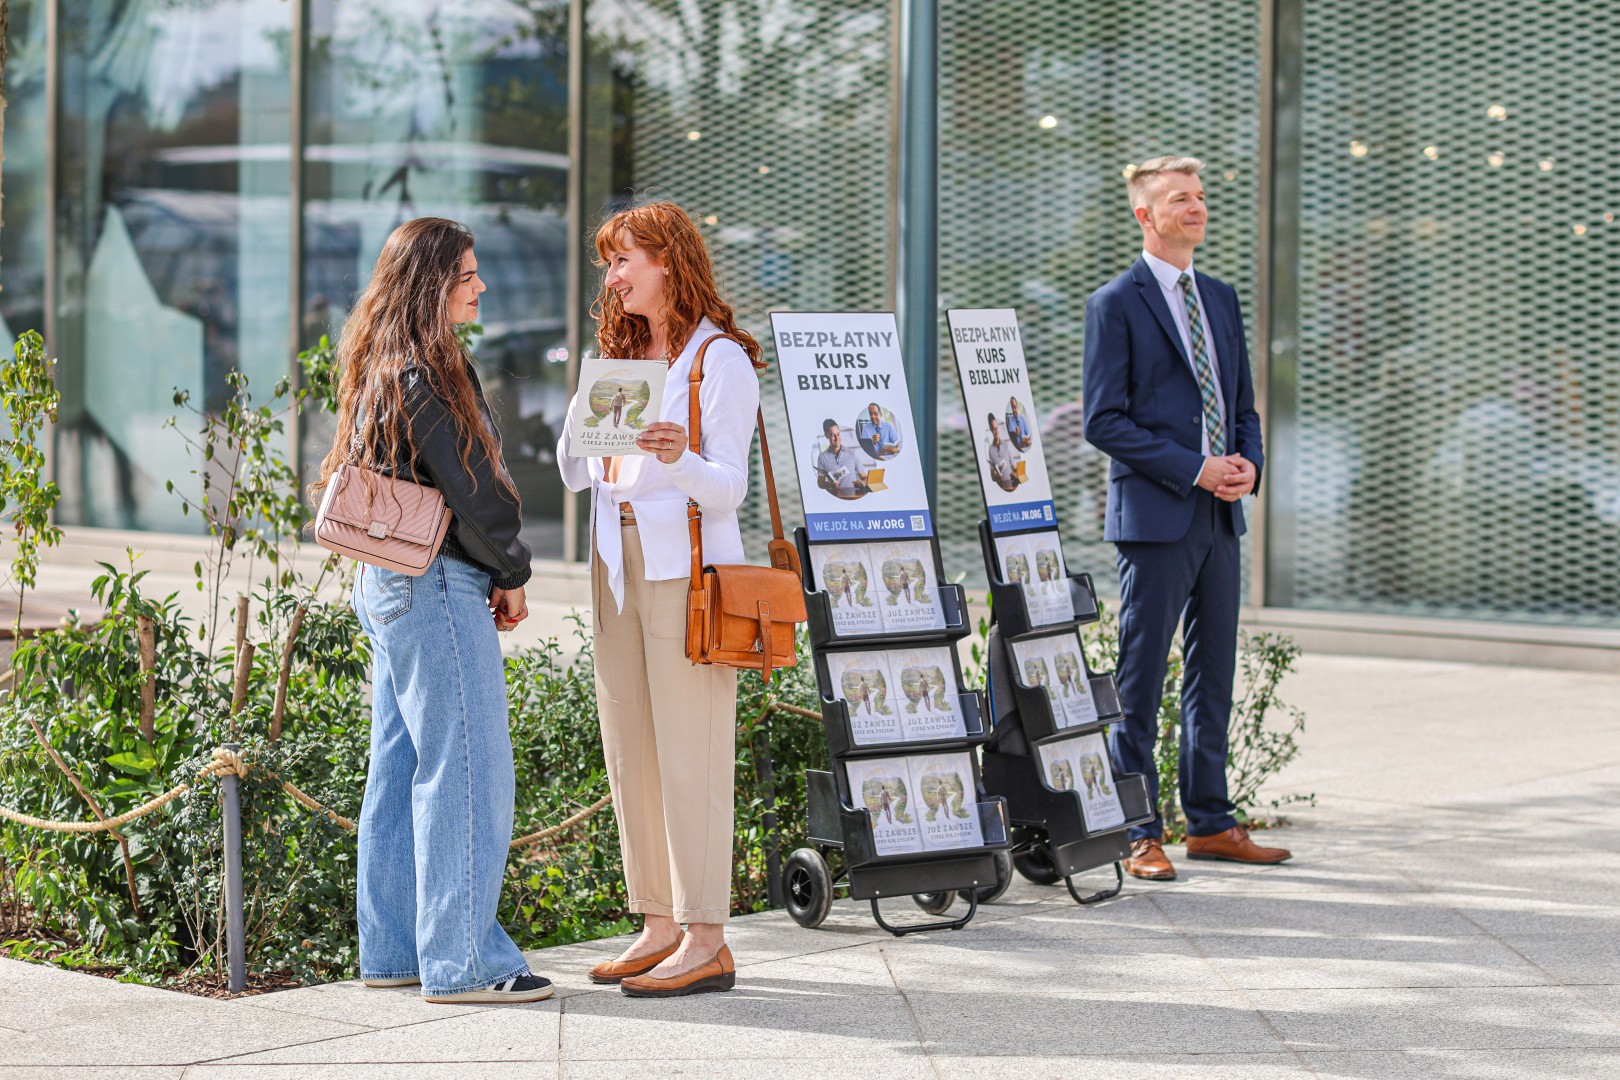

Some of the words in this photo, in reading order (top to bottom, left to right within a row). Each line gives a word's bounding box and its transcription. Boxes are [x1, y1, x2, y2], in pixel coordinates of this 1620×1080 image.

[779, 331, 892, 347] BEZPŁATNY
[954, 327, 1016, 343] BEZPŁATNY
[815, 353, 868, 368] KURS
[976, 347, 1006, 363] KURS
[797, 374, 891, 390] BIBLIJNY
[968, 368, 1020, 385] BIBLIJNY
[580, 431, 601, 440] JUŻ
[604, 432, 641, 441] ZAWSZ
[813, 519, 848, 531] WEJDŹ
[850, 520, 864, 530] NA
[867, 519, 905, 530] JW.ORG
[833, 612, 844, 620] UŻ
[845, 611, 877, 620] ZAWSZE
[905, 607, 936, 617] ZAWSZE
[852, 721, 862, 729] UŻ
[864, 719, 897, 728] ZAWSZE
[925, 715, 957, 724] ZAWSZE
[885, 827, 917, 838] ZAWSZE
[943, 822, 974, 832] ZAWSZE
